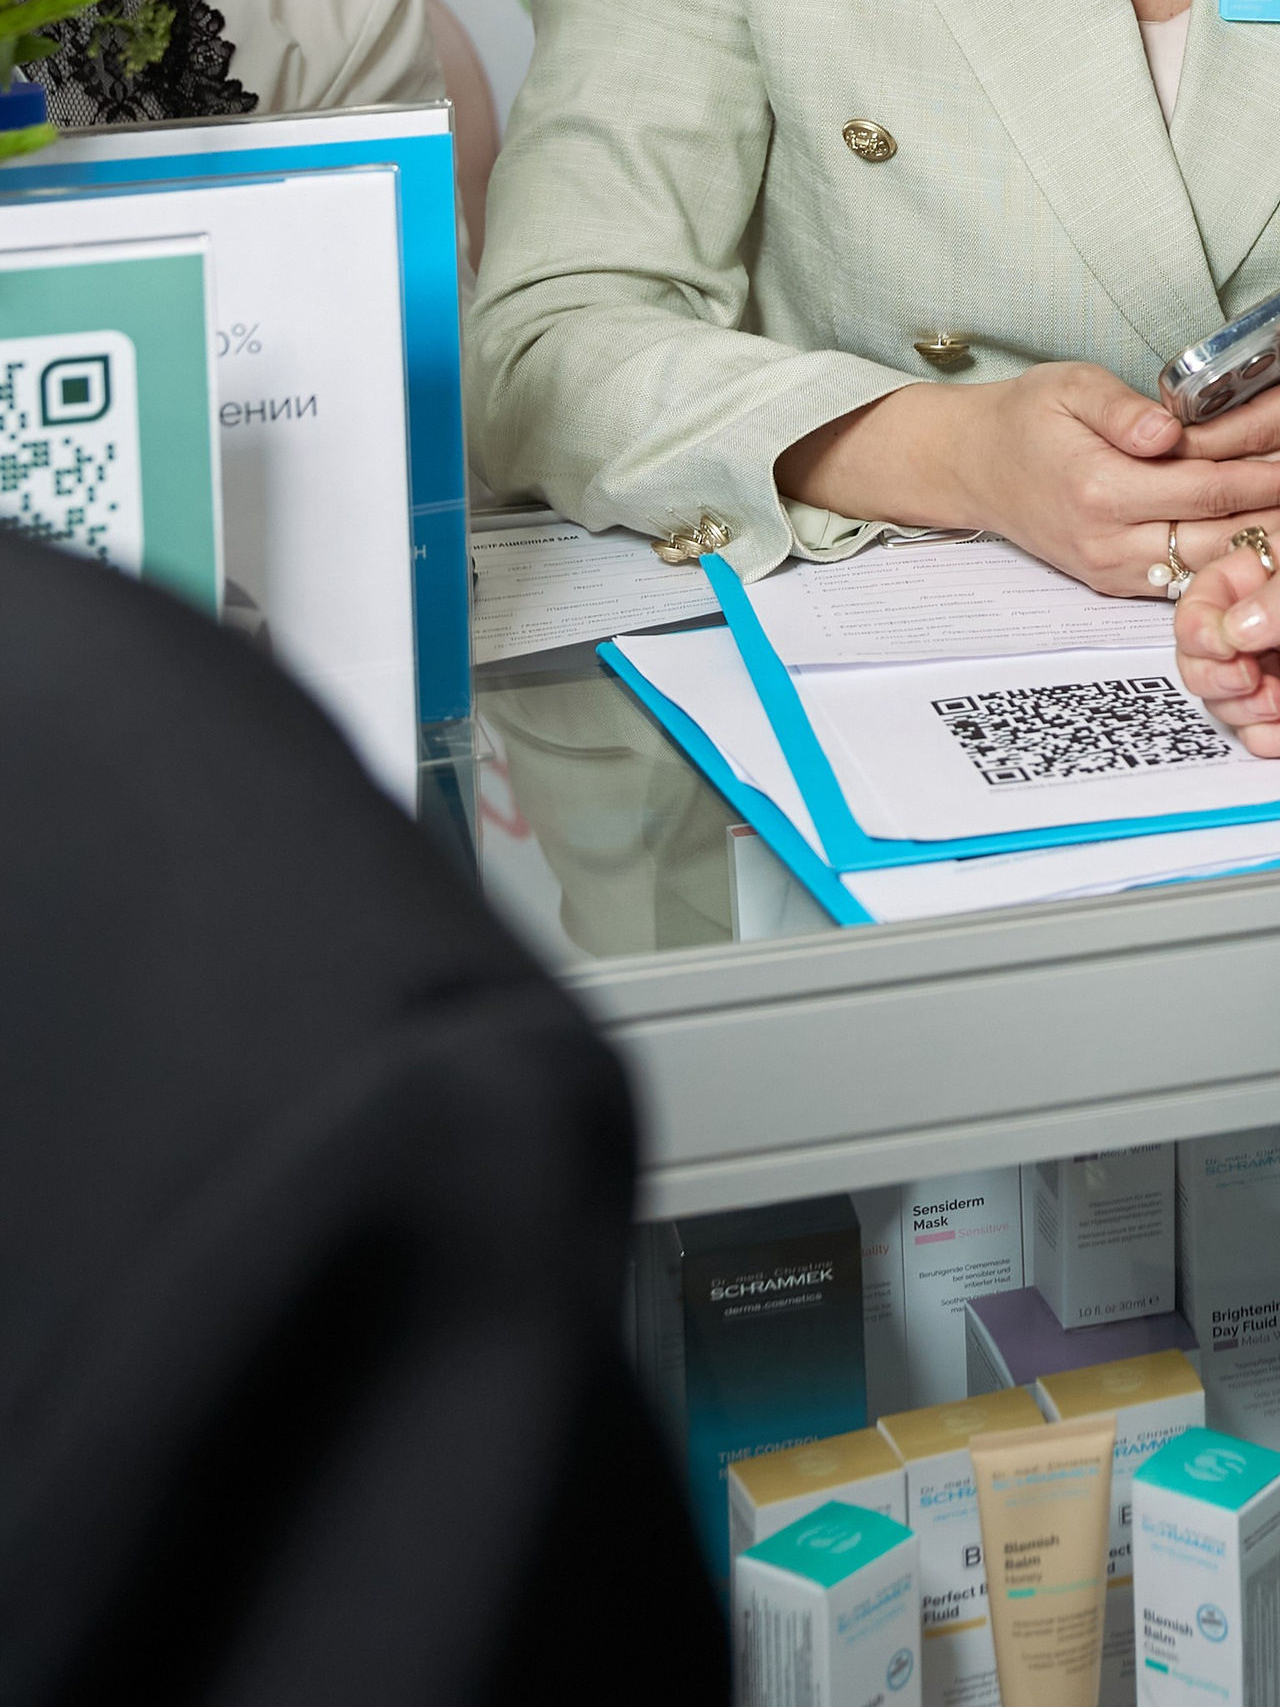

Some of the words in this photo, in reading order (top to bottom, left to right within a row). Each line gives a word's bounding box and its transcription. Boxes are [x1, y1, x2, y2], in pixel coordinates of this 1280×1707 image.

[912, 1196, 985, 1217] Sensiderm
[913, 1215, 949, 1232] Mask
[958, 1222, 1010, 1239] Sensitive
[774, 1260, 834, 1277] Christine
[919, 1265, 964, 1280] Beruhigende
[965, 1257, 1011, 1272] Crememaske
[952, 1274, 964, 1283] bei
[965, 1270, 995, 1281] sensibler
[996, 1266, 1011, 1275] und
[710, 1267, 834, 1302] SCHRAMMEK
[994, 1275, 1011, 1284] Haut
[723, 1292, 822, 1317] derma.cosmetics
[1212, 1324, 1239, 1339] Day
[1243, 1315, 1277, 1333] Fluid
[1004, 1535, 1060, 1555] Blemish
[1005, 1555, 1041, 1571] Balm
[922, 1586, 976, 1609] Perfect
[922, 1605, 960, 1625] Fluid
[1143, 1607, 1194, 1638] Blemish
[1144, 1624, 1176, 1646] Balm
